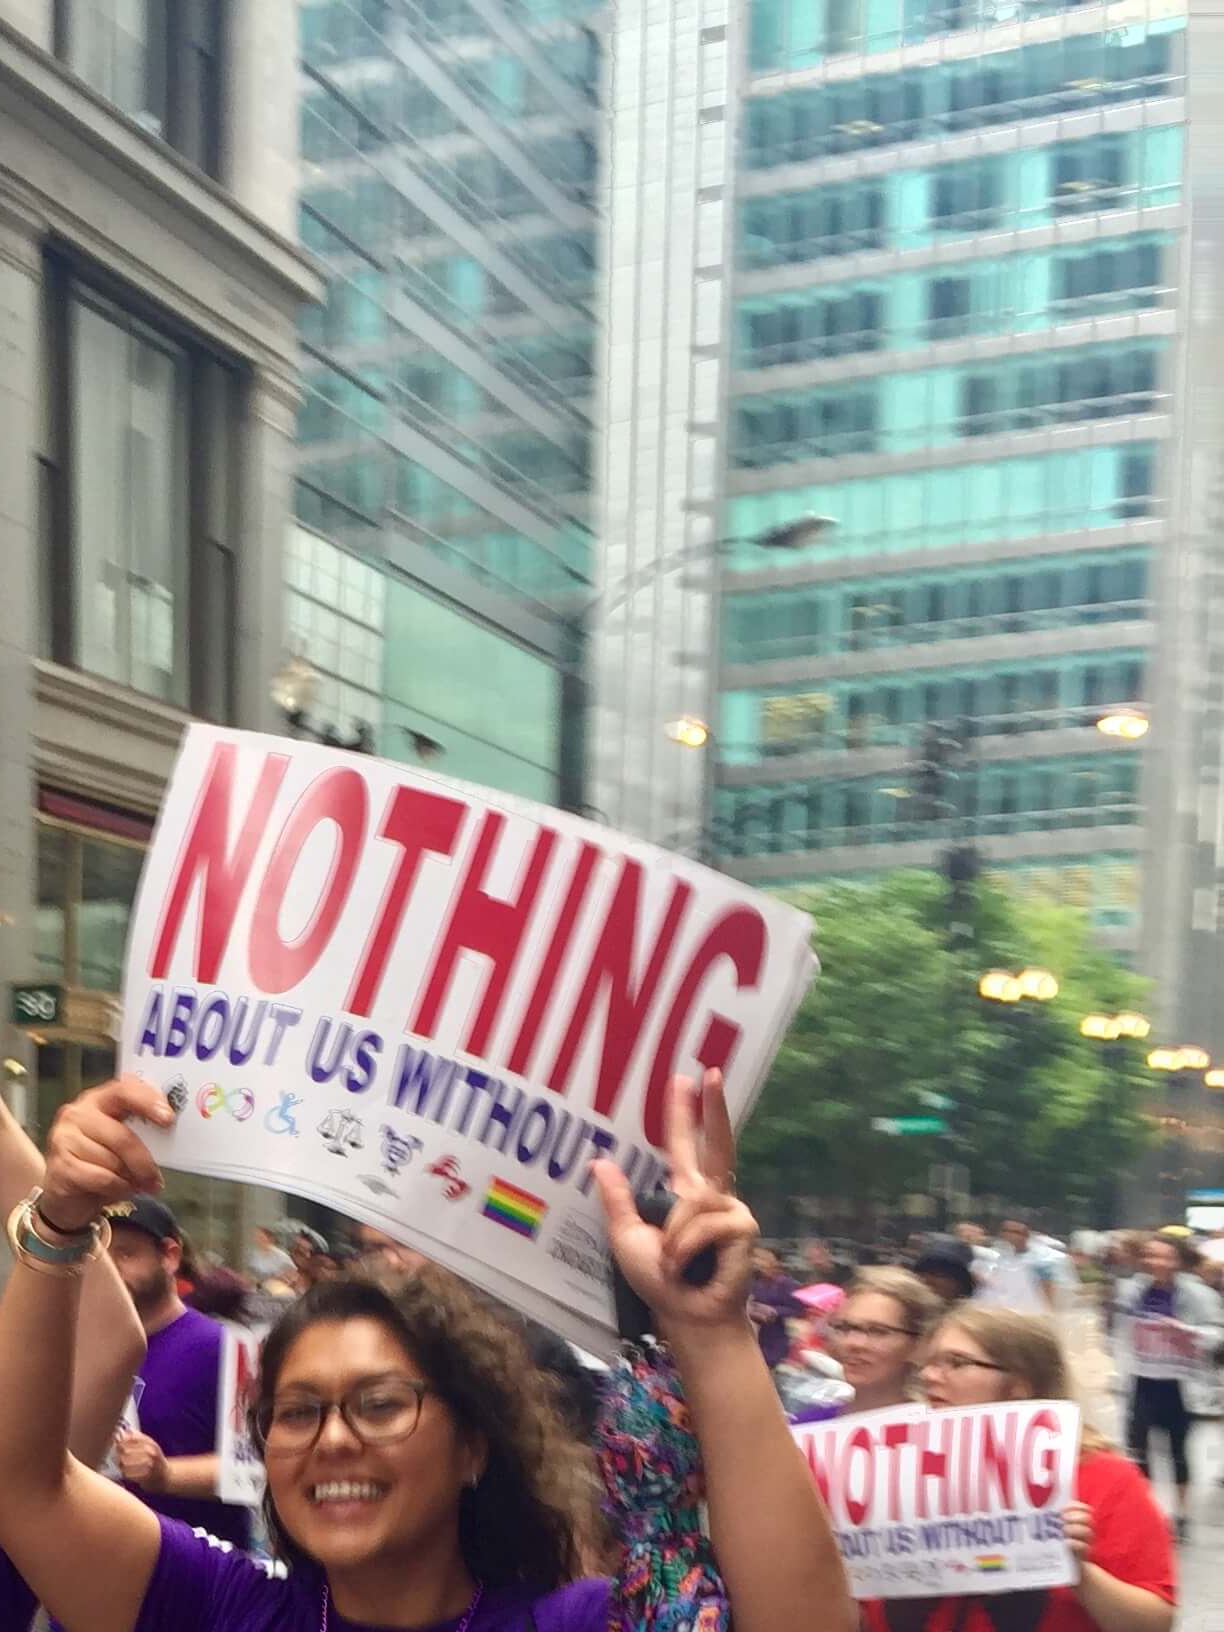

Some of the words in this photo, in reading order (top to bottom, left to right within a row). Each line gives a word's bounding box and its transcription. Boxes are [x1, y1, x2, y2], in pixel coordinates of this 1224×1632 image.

[148, 741, 769, 1150] NOTHING
[139, 986, 301, 1067] ABOUT
[306, 1016, 384, 1093] US
[389, 1043, 616, 1198] WITHOUT
[802, 1409, 1061, 1527] NOTHING
